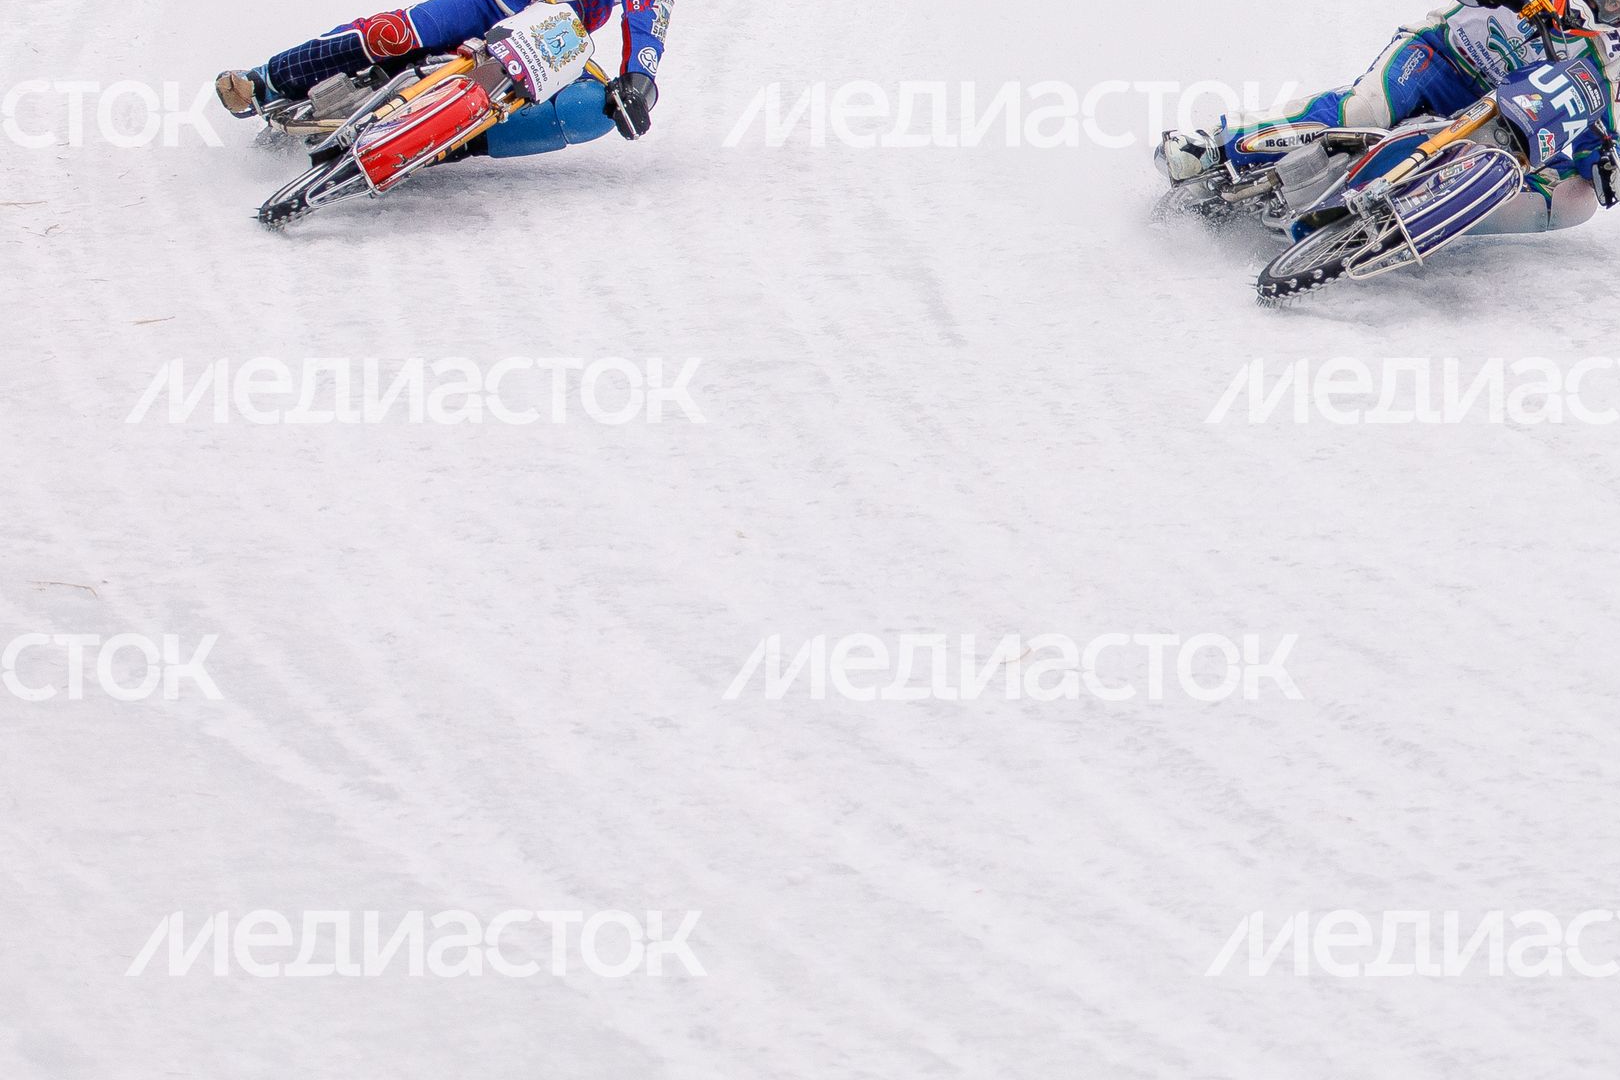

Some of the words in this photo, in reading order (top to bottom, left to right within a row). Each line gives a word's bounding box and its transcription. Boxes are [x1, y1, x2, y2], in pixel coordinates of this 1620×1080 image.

[491, 41, 510, 58] EGA
[510, 36, 532, 64] марской
[530, 64, 543, 92] области
[516, 31, 548, 82] Правительство
[1456, 27, 1485, 69] РЕСПУБЛИКИ
[1528, 64, 1588, 148] UFA
